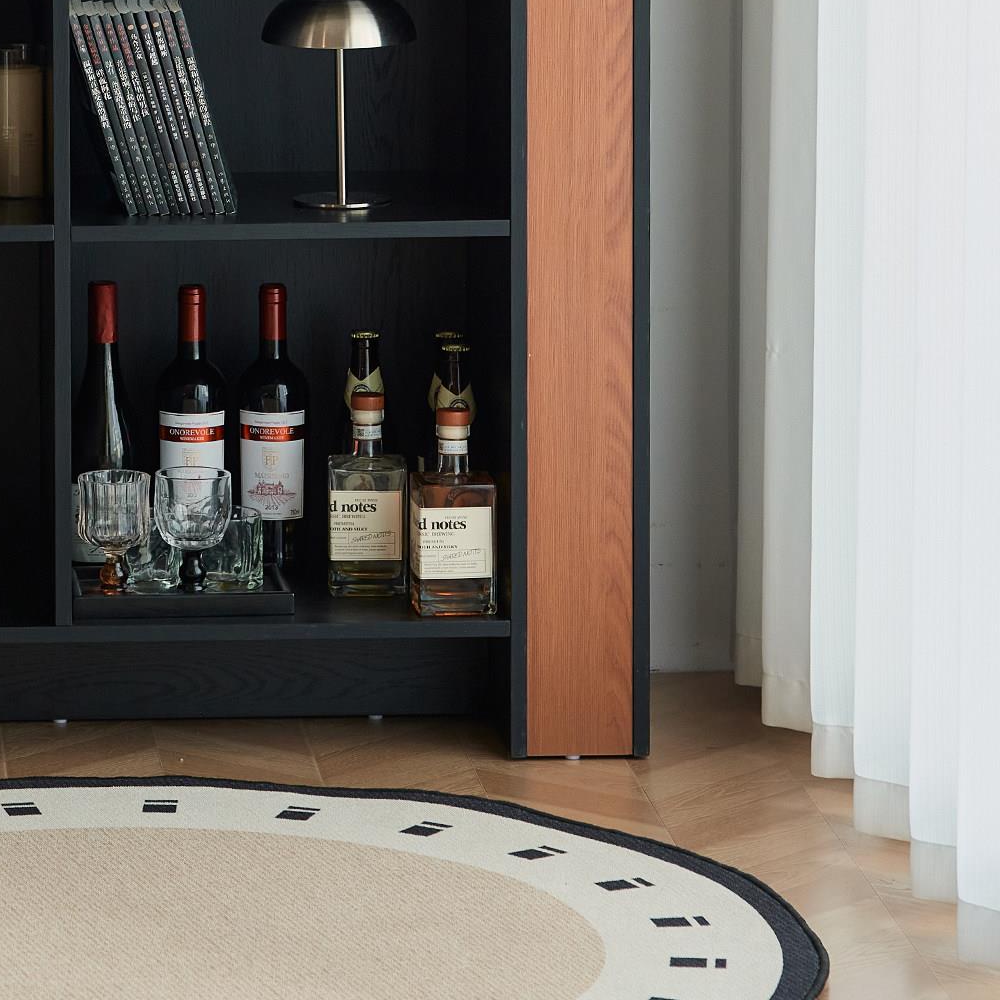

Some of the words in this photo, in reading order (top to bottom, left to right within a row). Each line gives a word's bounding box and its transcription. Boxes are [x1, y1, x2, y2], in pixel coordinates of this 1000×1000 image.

[169, 428, 215, 436] ONOREVOLE
[249, 427, 295, 435] ONOREVOLE
[341, 502, 377, 513] notes
[431, 519, 467, 530] notes
